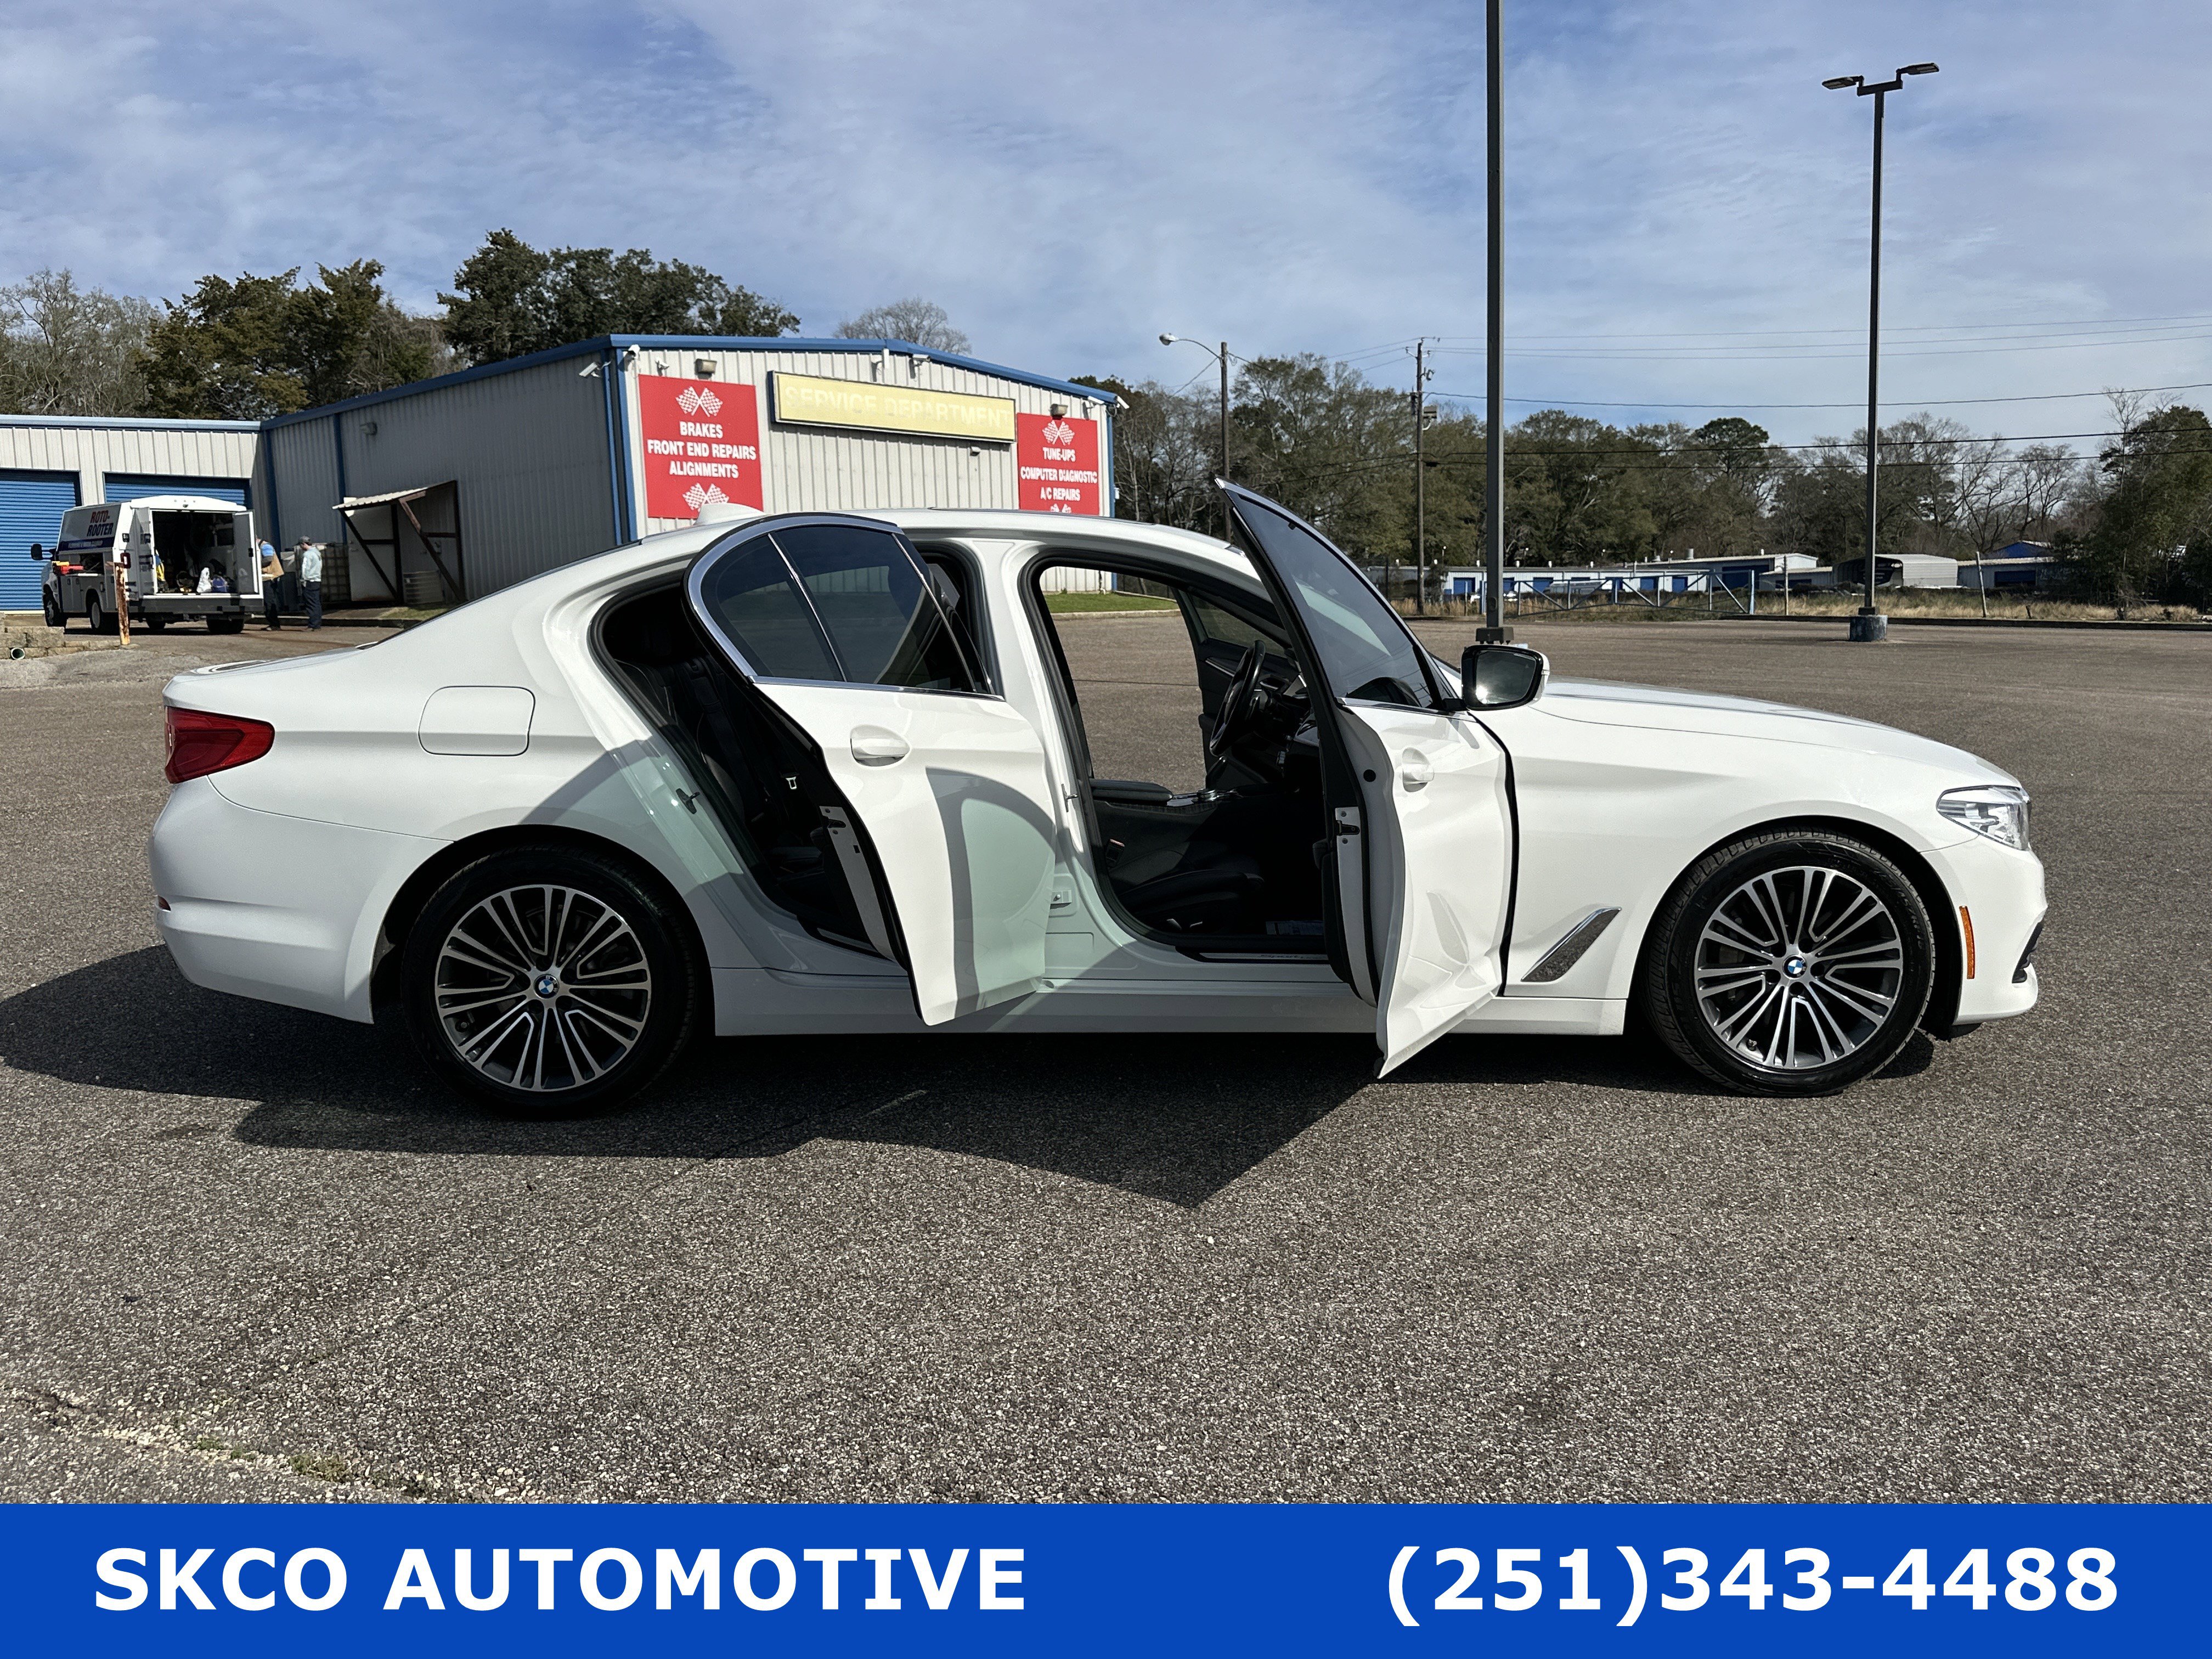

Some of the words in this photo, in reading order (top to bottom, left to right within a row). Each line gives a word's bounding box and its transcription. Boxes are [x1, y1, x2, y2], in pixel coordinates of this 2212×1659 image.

[884, 398, 1012, 428] DEPARTMENT
[679, 421, 724, 438] BRAKES
[647, 439, 685, 456] FRONT
[686, 442, 709, 458] END
[711, 443, 757, 460] REPAIRS
[1042, 447, 1076, 462] TUNE-UPS
[669, 460, 740, 479] ALIGNMENTS
[1020, 466, 1058, 481] COMPUTER
[1058, 469, 1098, 484] DIAGNOSTIC
[1053, 487, 1081, 501] REPAIRS
[86, 523, 114, 537] ROOTER
